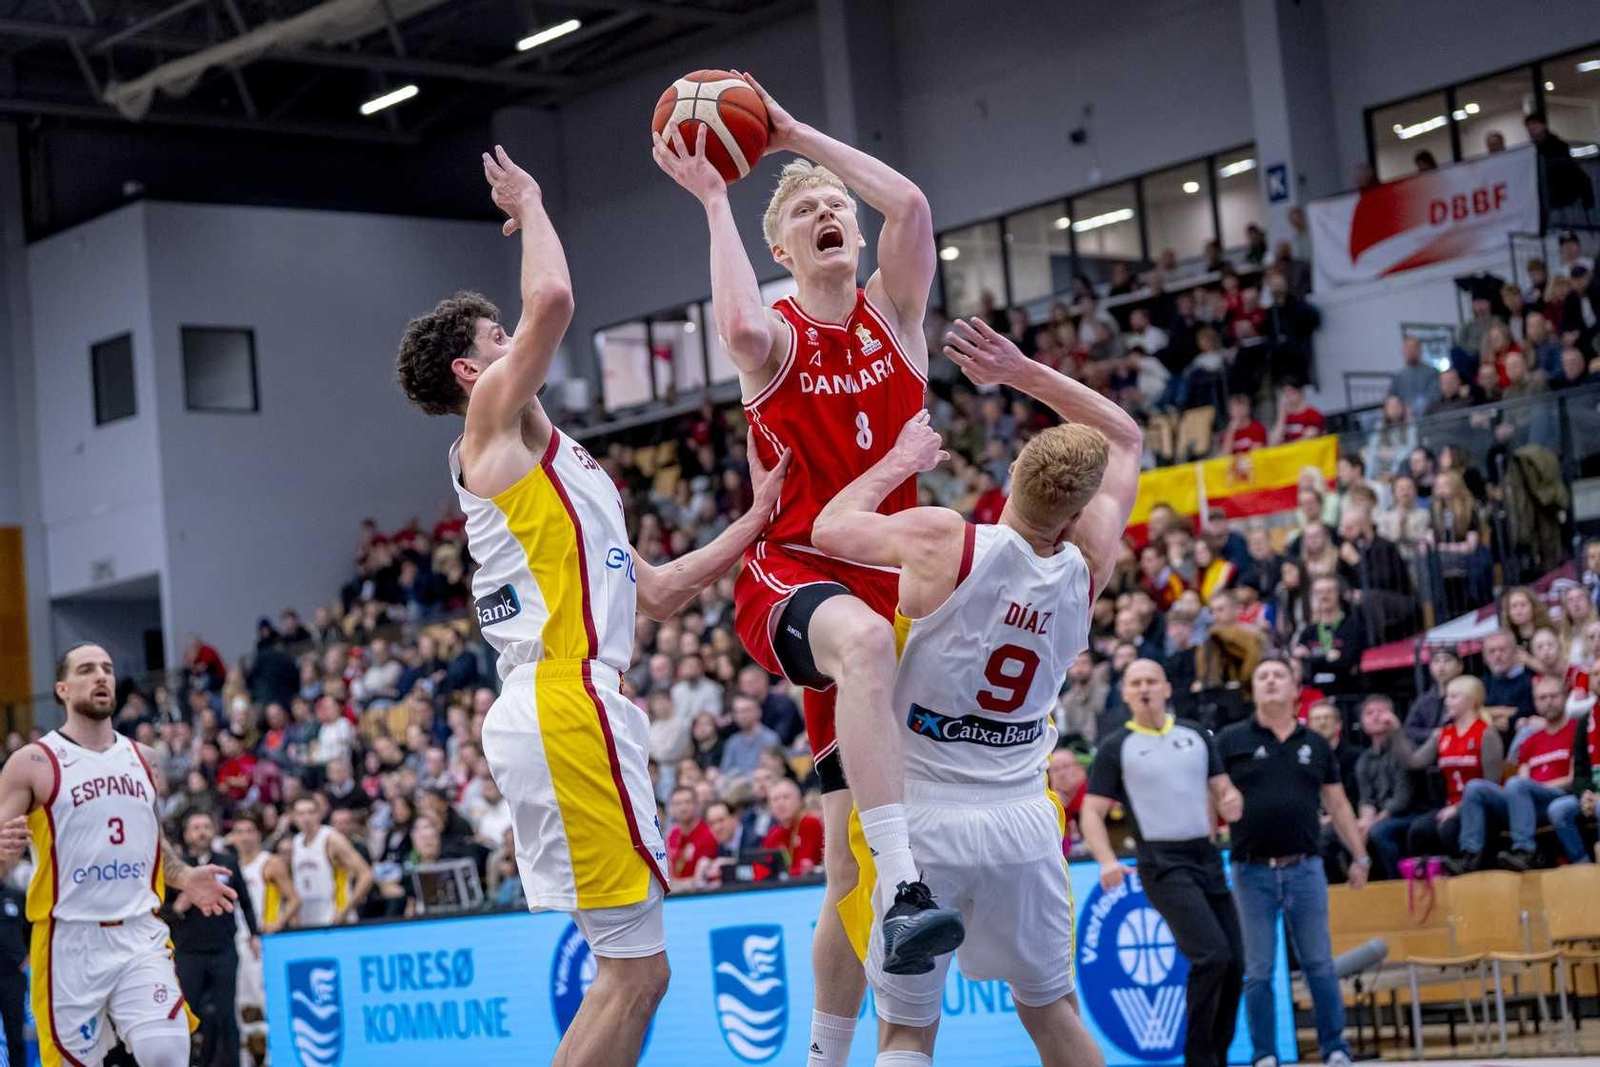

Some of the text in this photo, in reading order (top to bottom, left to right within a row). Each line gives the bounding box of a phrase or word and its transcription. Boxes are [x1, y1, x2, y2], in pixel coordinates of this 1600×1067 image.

[1429, 182, 1508, 225] DBBF
[855, 411, 873, 450] 8
[1003, 601, 1052, 635] DÍAZ
[975, 643, 1041, 714] 9
[71, 773, 148, 808] ESPAÑA
[107, 817, 125, 845] 3
[359, 947, 475, 994] FURESØ
[362, 997, 512, 1043] KOMMUNE
